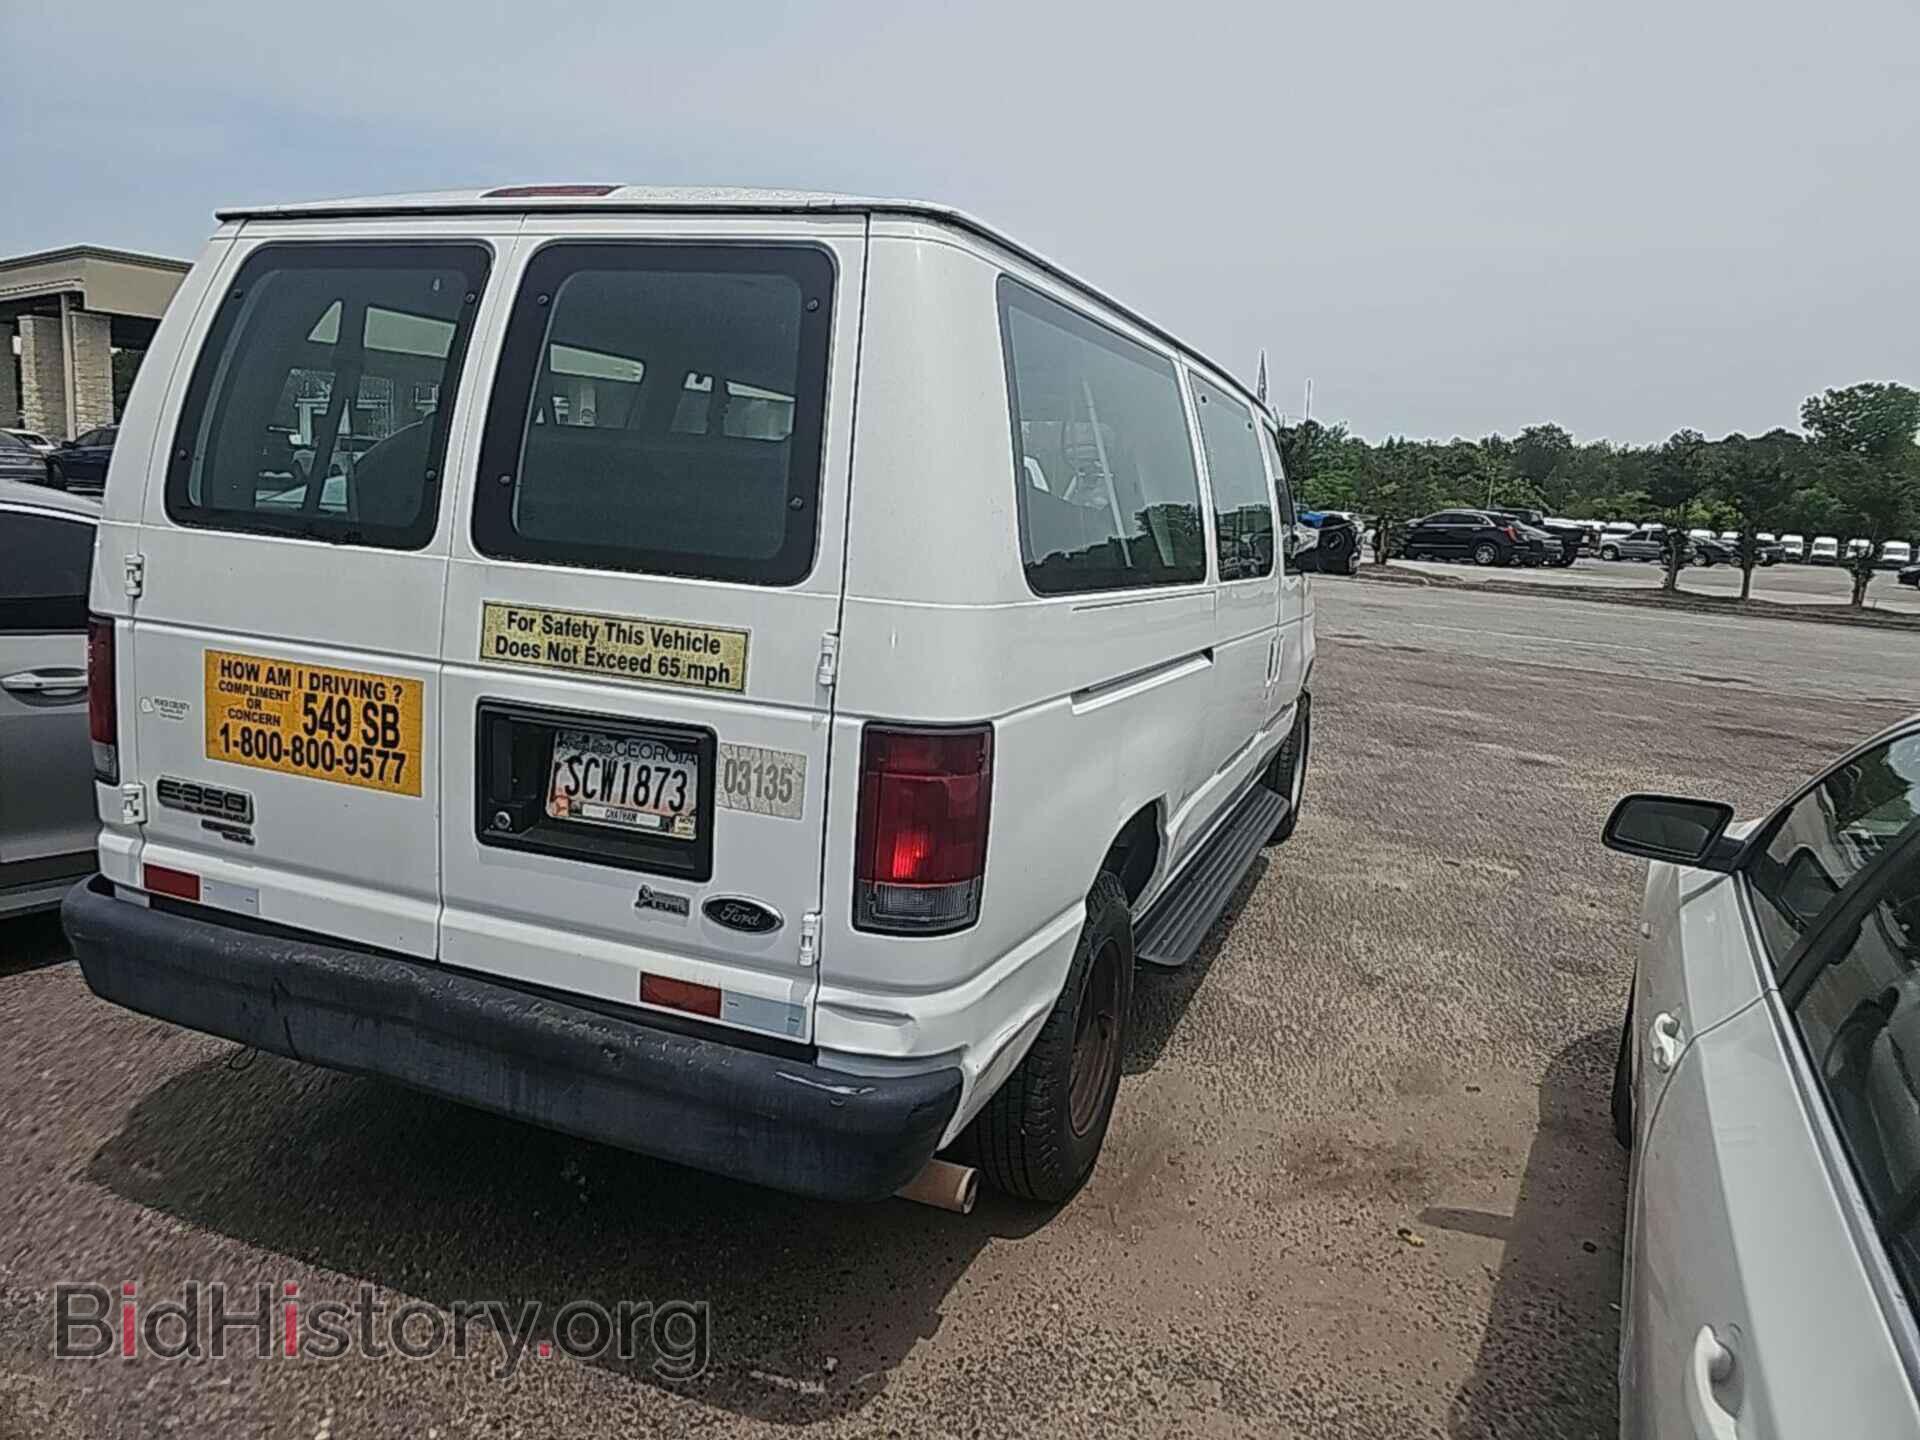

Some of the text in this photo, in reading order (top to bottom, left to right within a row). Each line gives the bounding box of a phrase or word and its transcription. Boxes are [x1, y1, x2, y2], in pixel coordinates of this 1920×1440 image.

[507, 611, 721, 654] For Safety This Vehicle
[220, 659, 403, 704] HOW AM I DRIVING ?
[495, 635, 730, 686] Does Not Exceed 65 mph
[218, 680, 291, 702] COMPLIMENT
[246, 698, 262, 711] OR
[228, 708, 281, 727] CONCERN
[303, 693, 401, 749] 549 SB
[219, 723, 406, 785] 1-800-800-9577
[614, 740, 697, 765] GEORGIA
[565, 755, 688, 812] SCW1873
[724, 758, 793, 803] 03135
[719, 903, 761, 927] Ford
